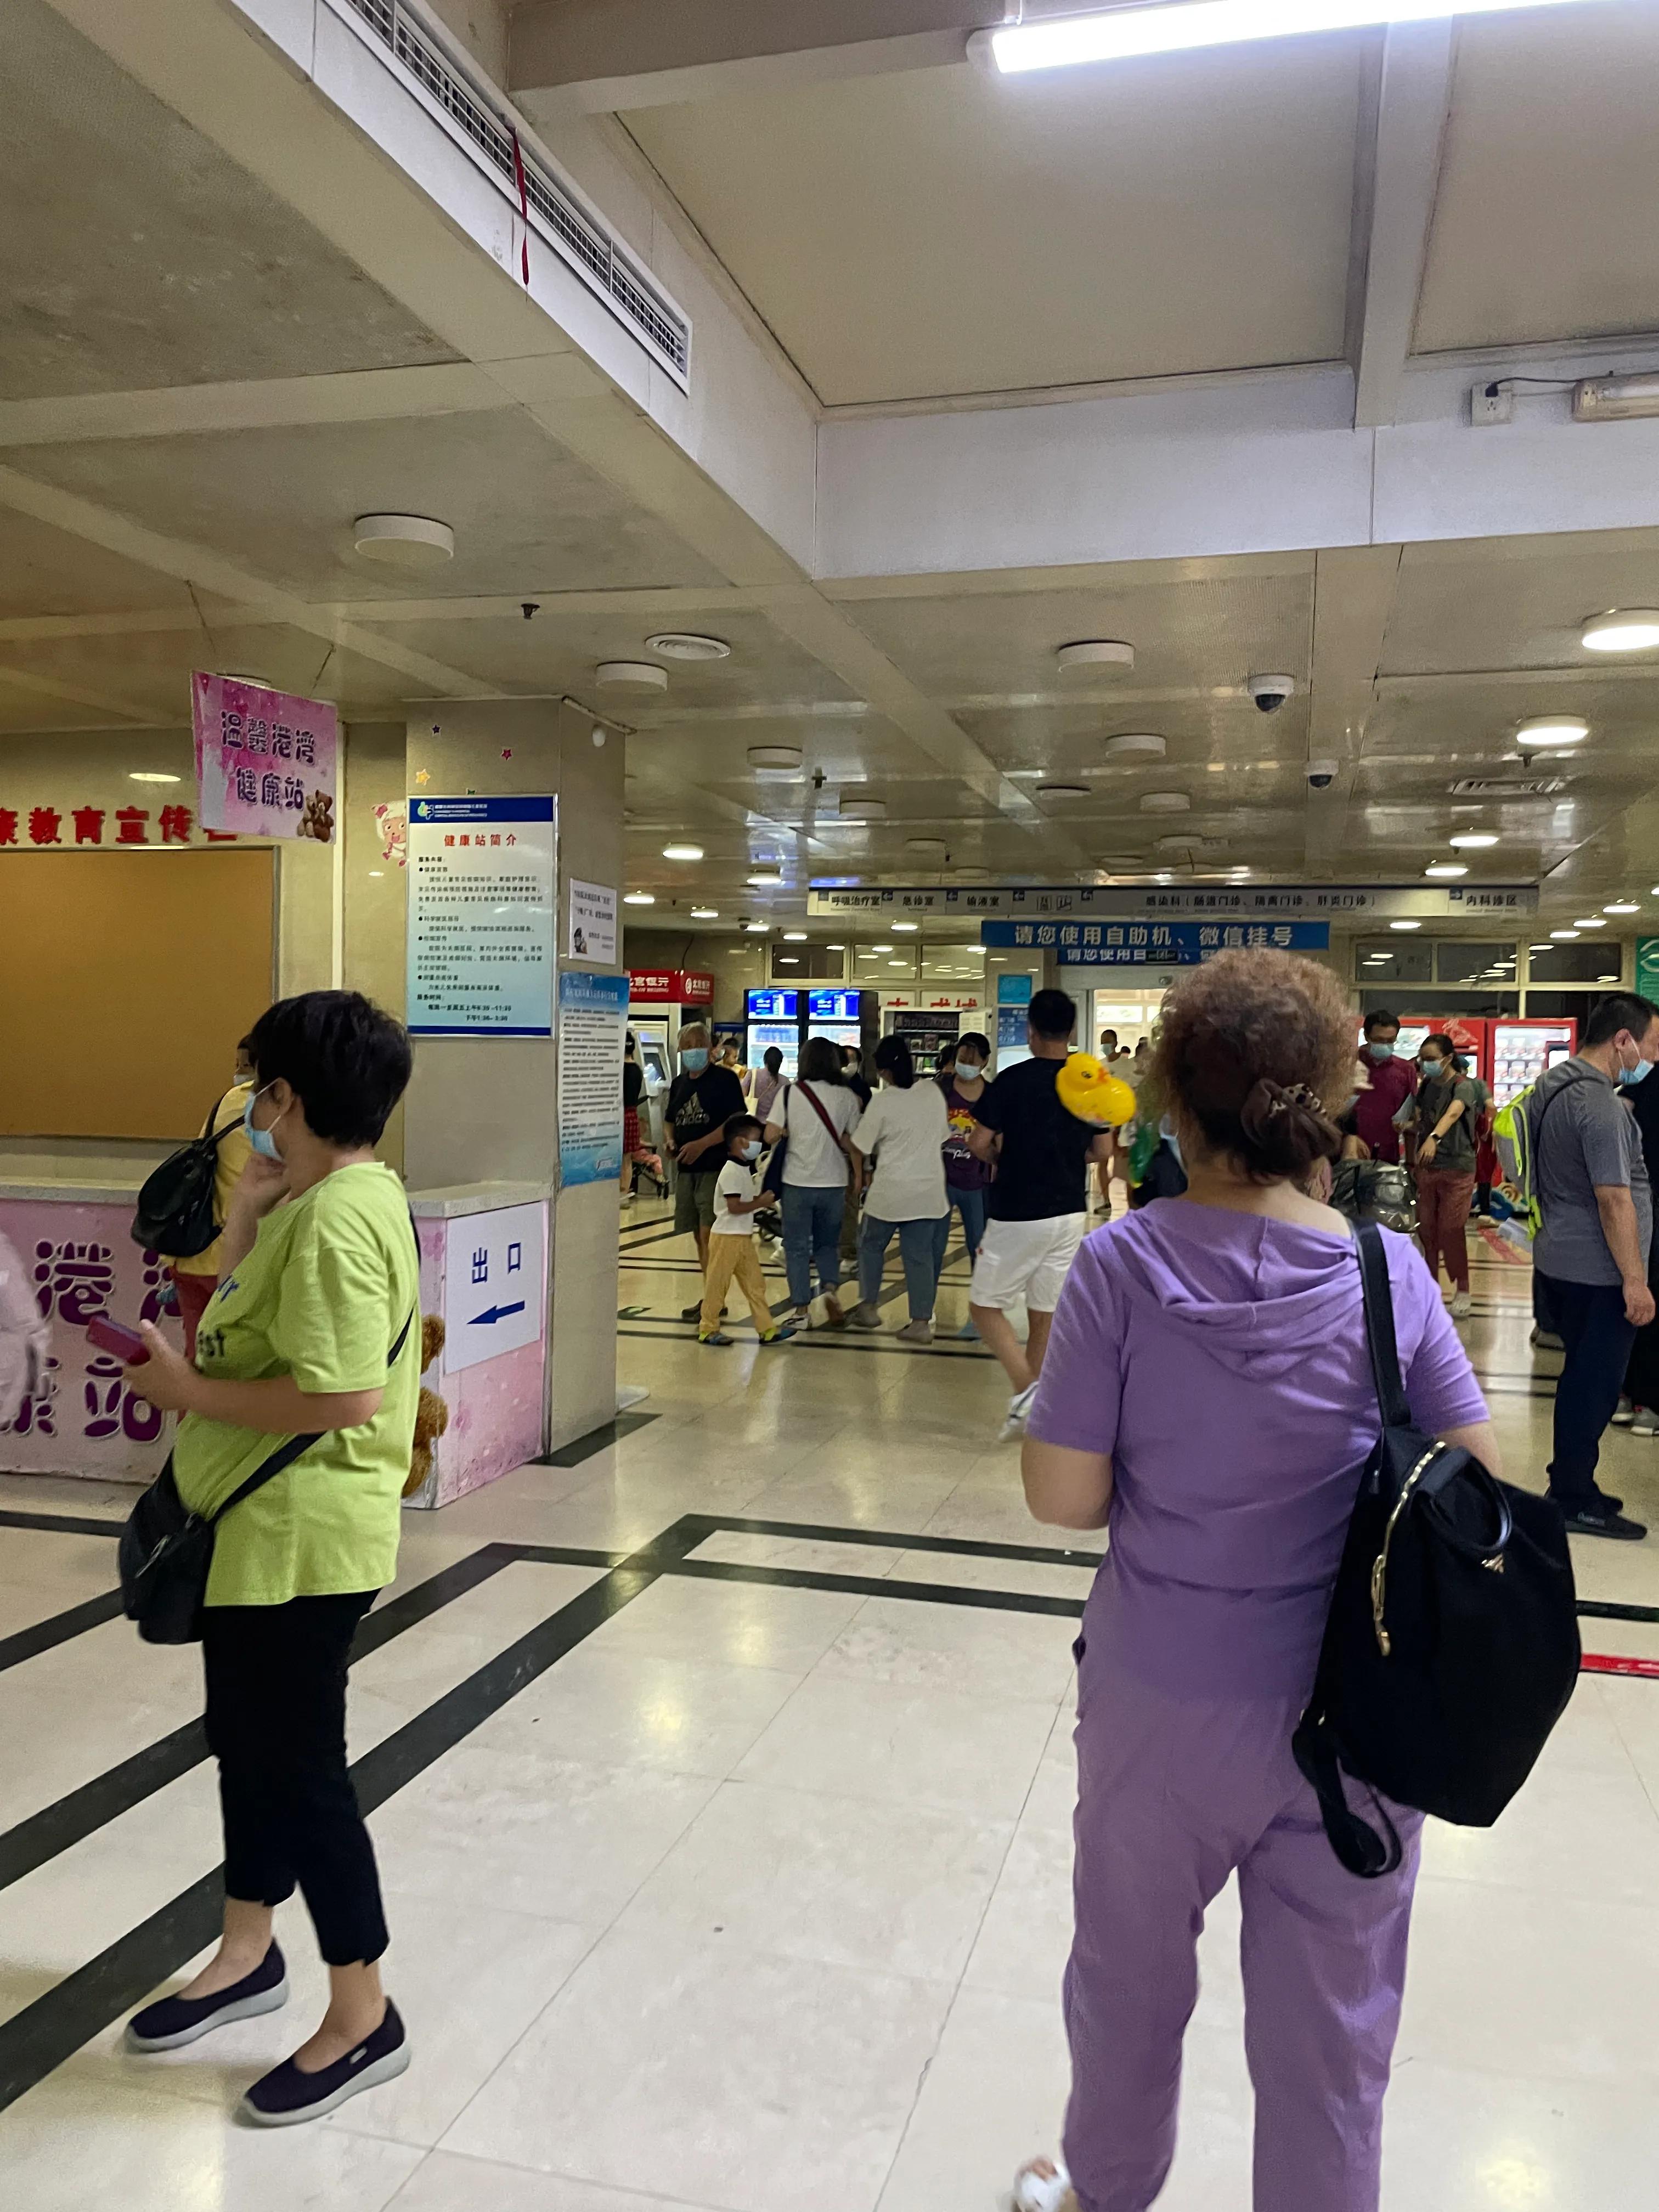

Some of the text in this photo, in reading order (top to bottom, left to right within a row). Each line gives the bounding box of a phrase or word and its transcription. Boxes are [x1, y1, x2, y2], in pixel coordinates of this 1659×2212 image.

[221, 711, 316, 765] 温馨港湾
[235, 766, 304, 810] 健康站
[444, 833, 517, 847] 健康站简介
[831, 896, 881, 907] 呼吸治疗室
[902, 895, 934, 906] 急诊室
[967, 895, 1000, 907] 输液室
[1466, 894, 1517, 907] 内科诊区
[1014, 924, 1293, 947] 请您使用自助机、微信挂号
[471, 1242, 522, 1284] 出口
